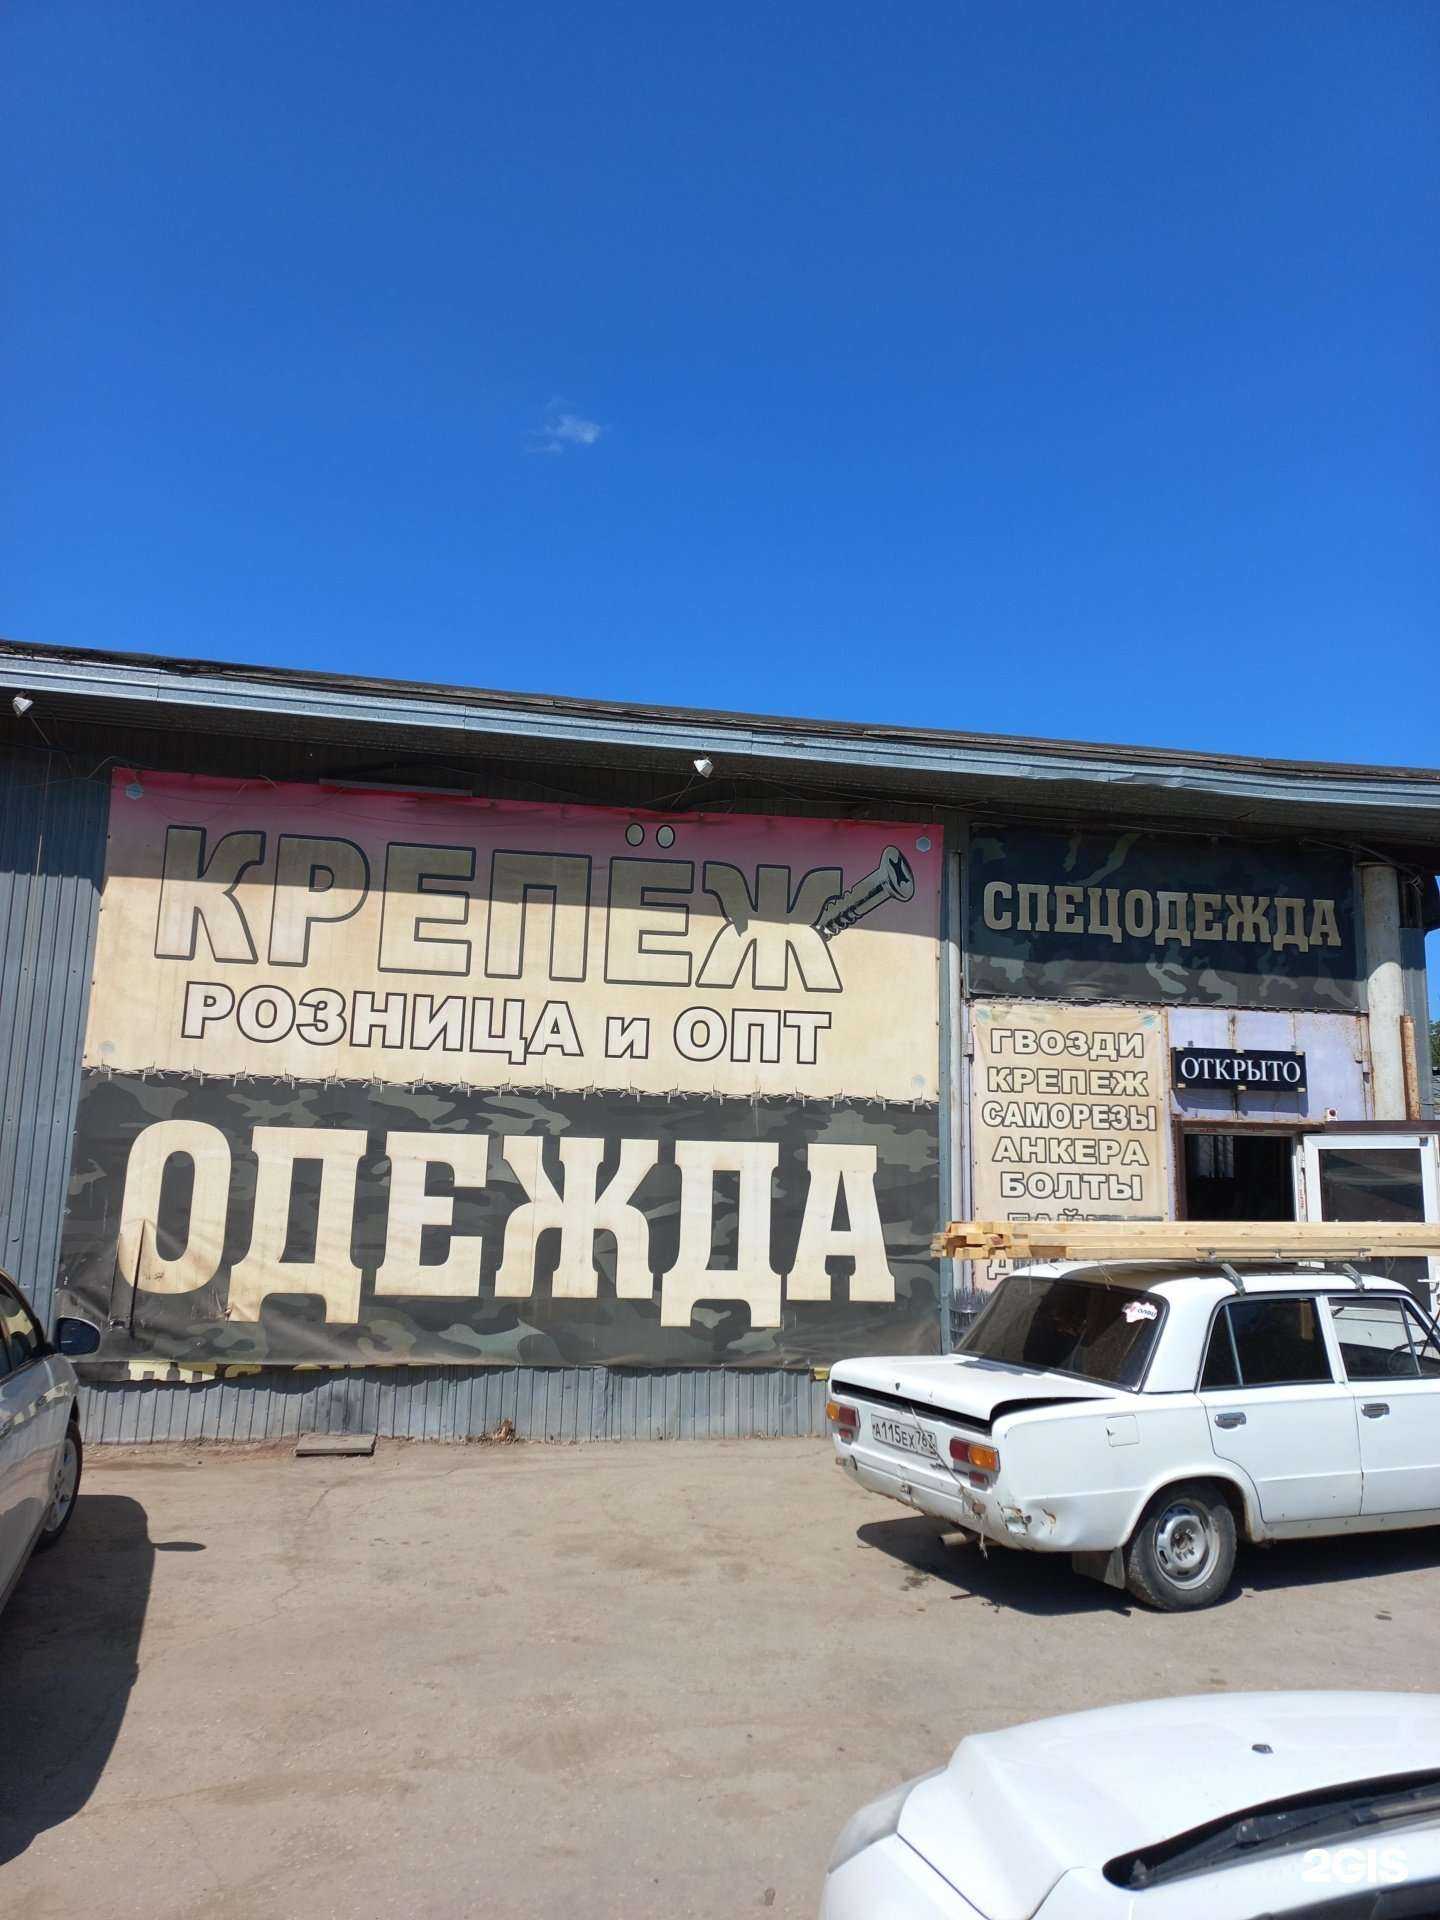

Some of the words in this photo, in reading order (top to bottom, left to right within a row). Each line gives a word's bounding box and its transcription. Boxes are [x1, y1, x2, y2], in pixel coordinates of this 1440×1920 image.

[154, 823, 843, 992] КРЕПЁЖ
[983, 881, 1342, 953] СПЕЦОДЕЖДА
[181, 980, 584, 1066] РОЗНИЦА
[605, 1016, 650, 1059] и
[673, 1005, 832, 1065] ОПТ
[990, 1028, 1144, 1062] ГВОЗДИ
[987, 1066, 1149, 1097] КРЕПЕЖ
[1181, 1057, 1301, 1083] ОТКРЫТО
[982, 1100, 1157, 1131] САМОРЕЗЫ
[992, 1136, 1150, 1166] АНКЕРА
[1000, 1171, 1143, 1201] БОЛТЫ
[118, 1119, 895, 1328] ОДЕЖДА
